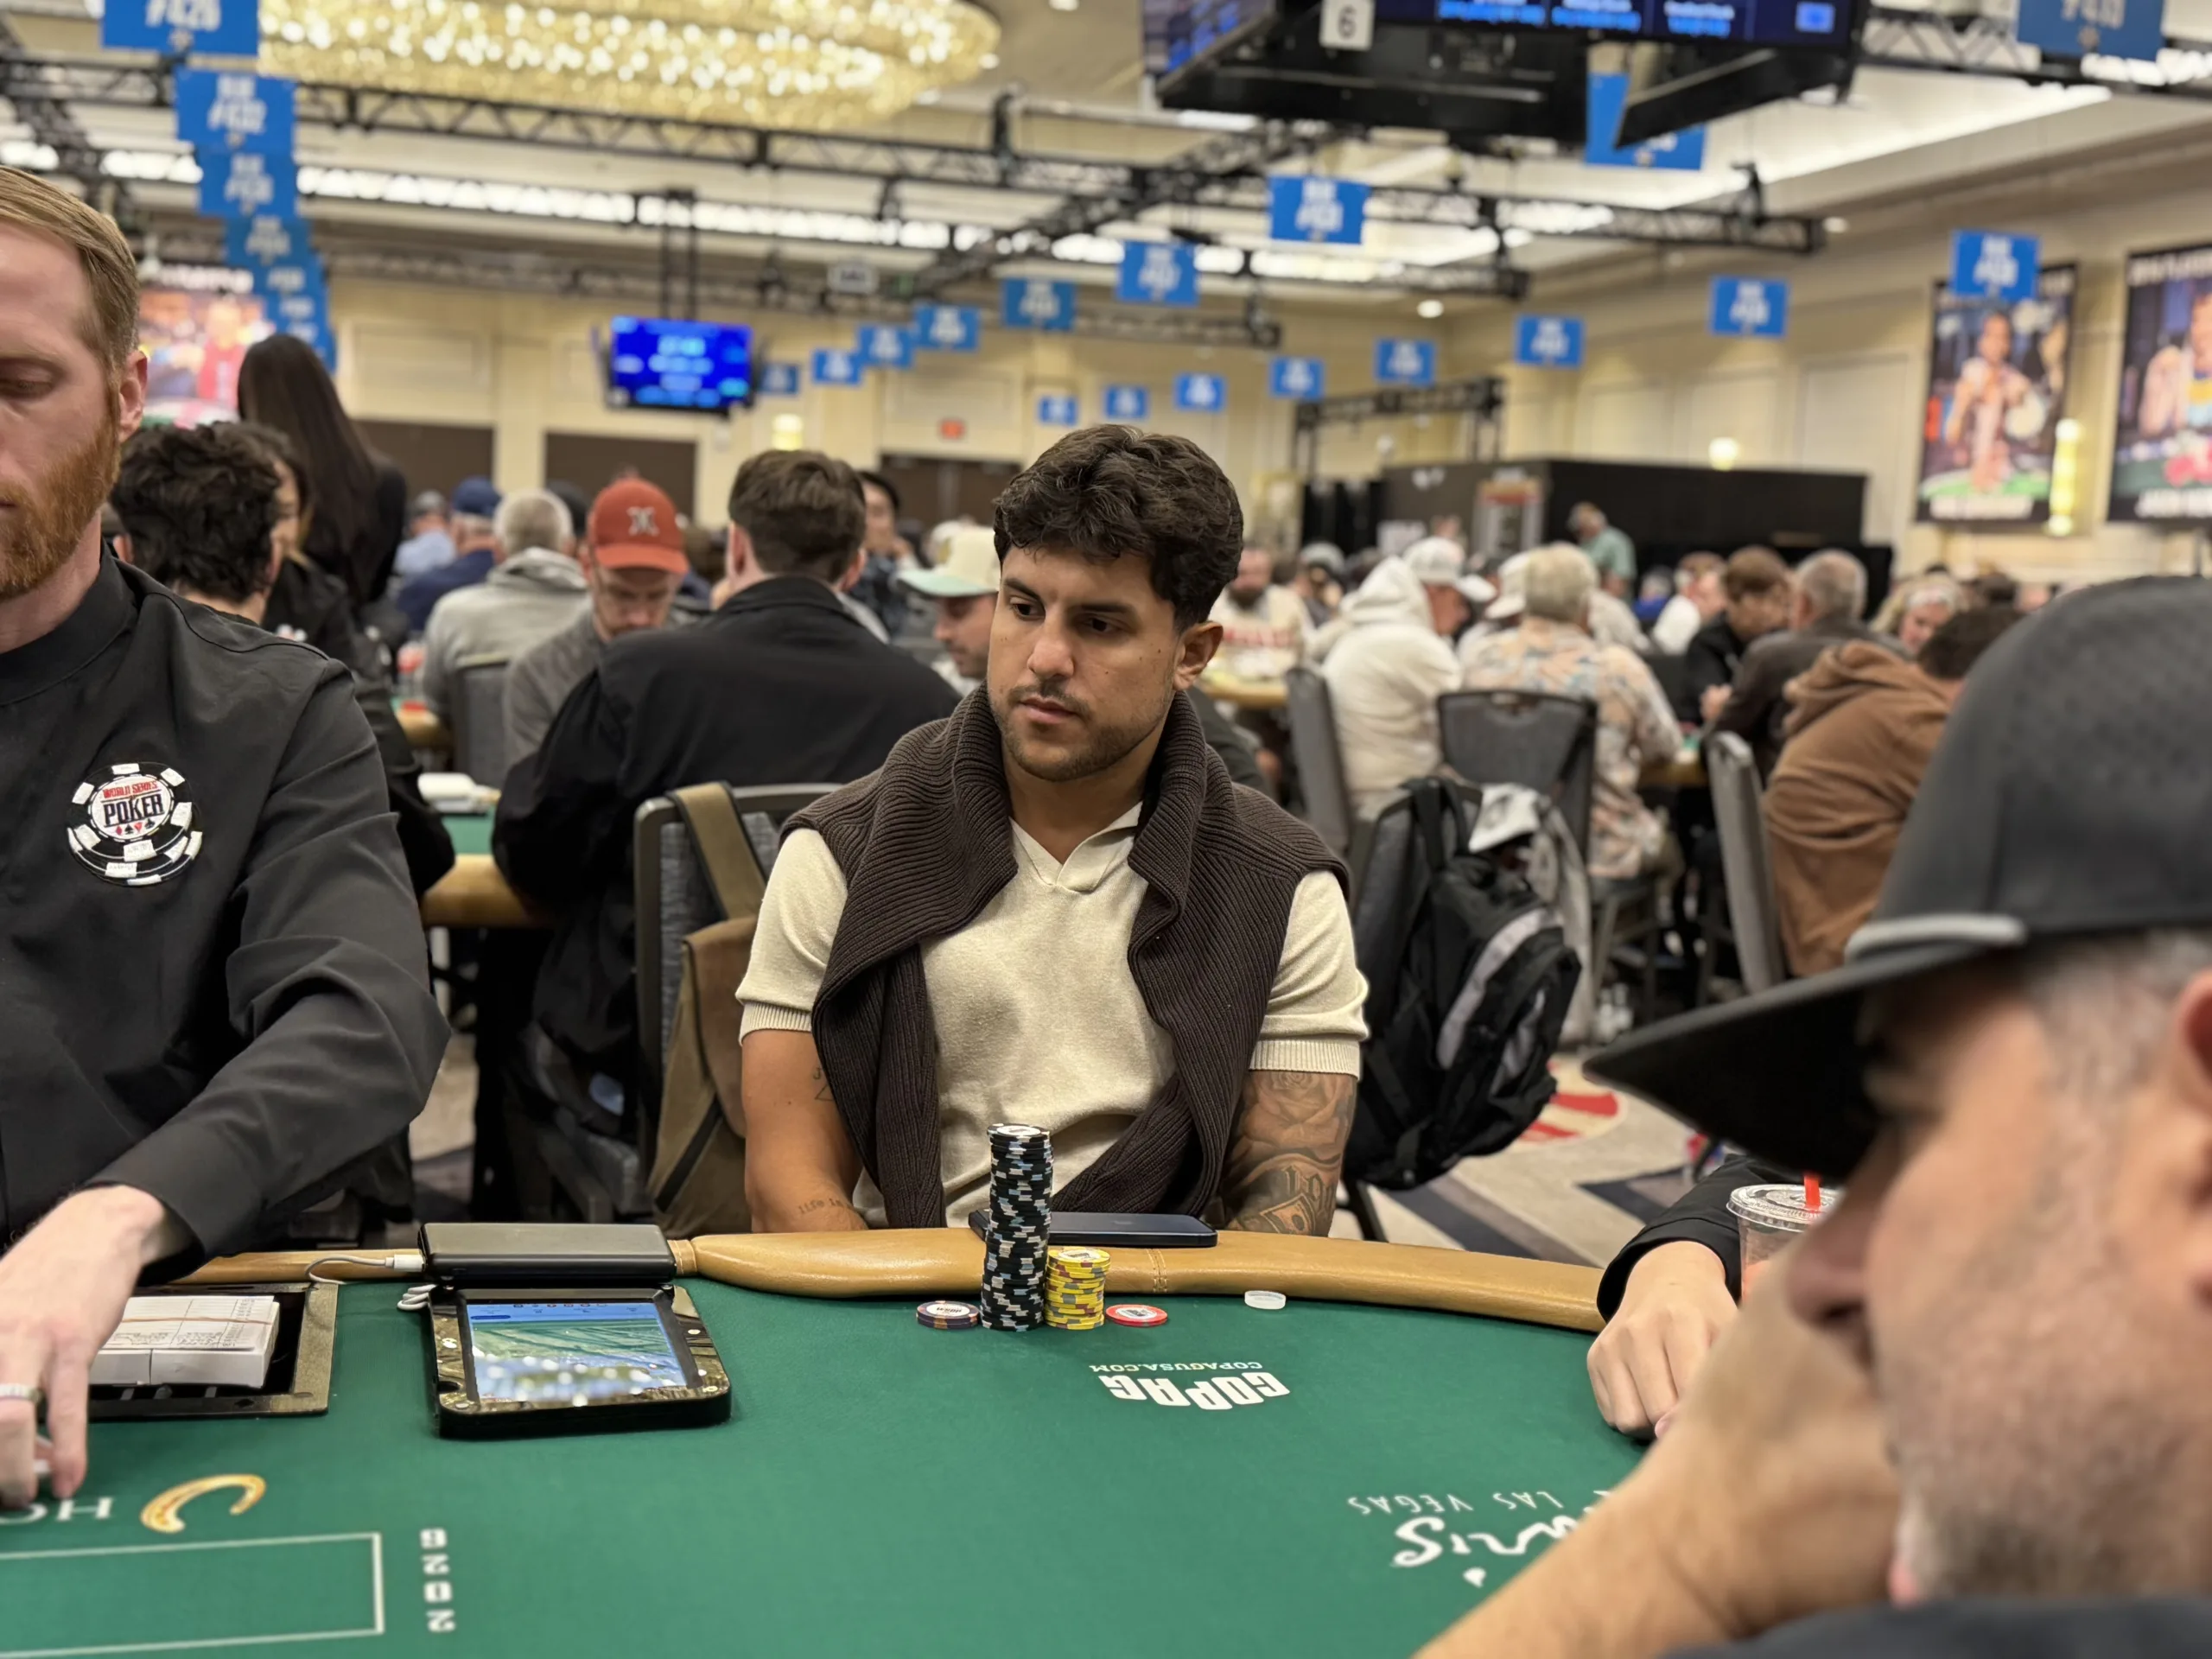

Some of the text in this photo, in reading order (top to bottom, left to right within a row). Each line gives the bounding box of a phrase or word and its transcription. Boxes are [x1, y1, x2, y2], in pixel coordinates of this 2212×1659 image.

[1337, 3, 1357, 41] 6
[103, 794, 164, 825] POKER
[1089, 1362, 1263, 1372] COPAGUSA.COM
[1098, 1371, 1291, 1410] COPAG
[1348, 1491, 1564, 1515] LAS VEGAS
[419, 1526, 456, 1633] 2026
